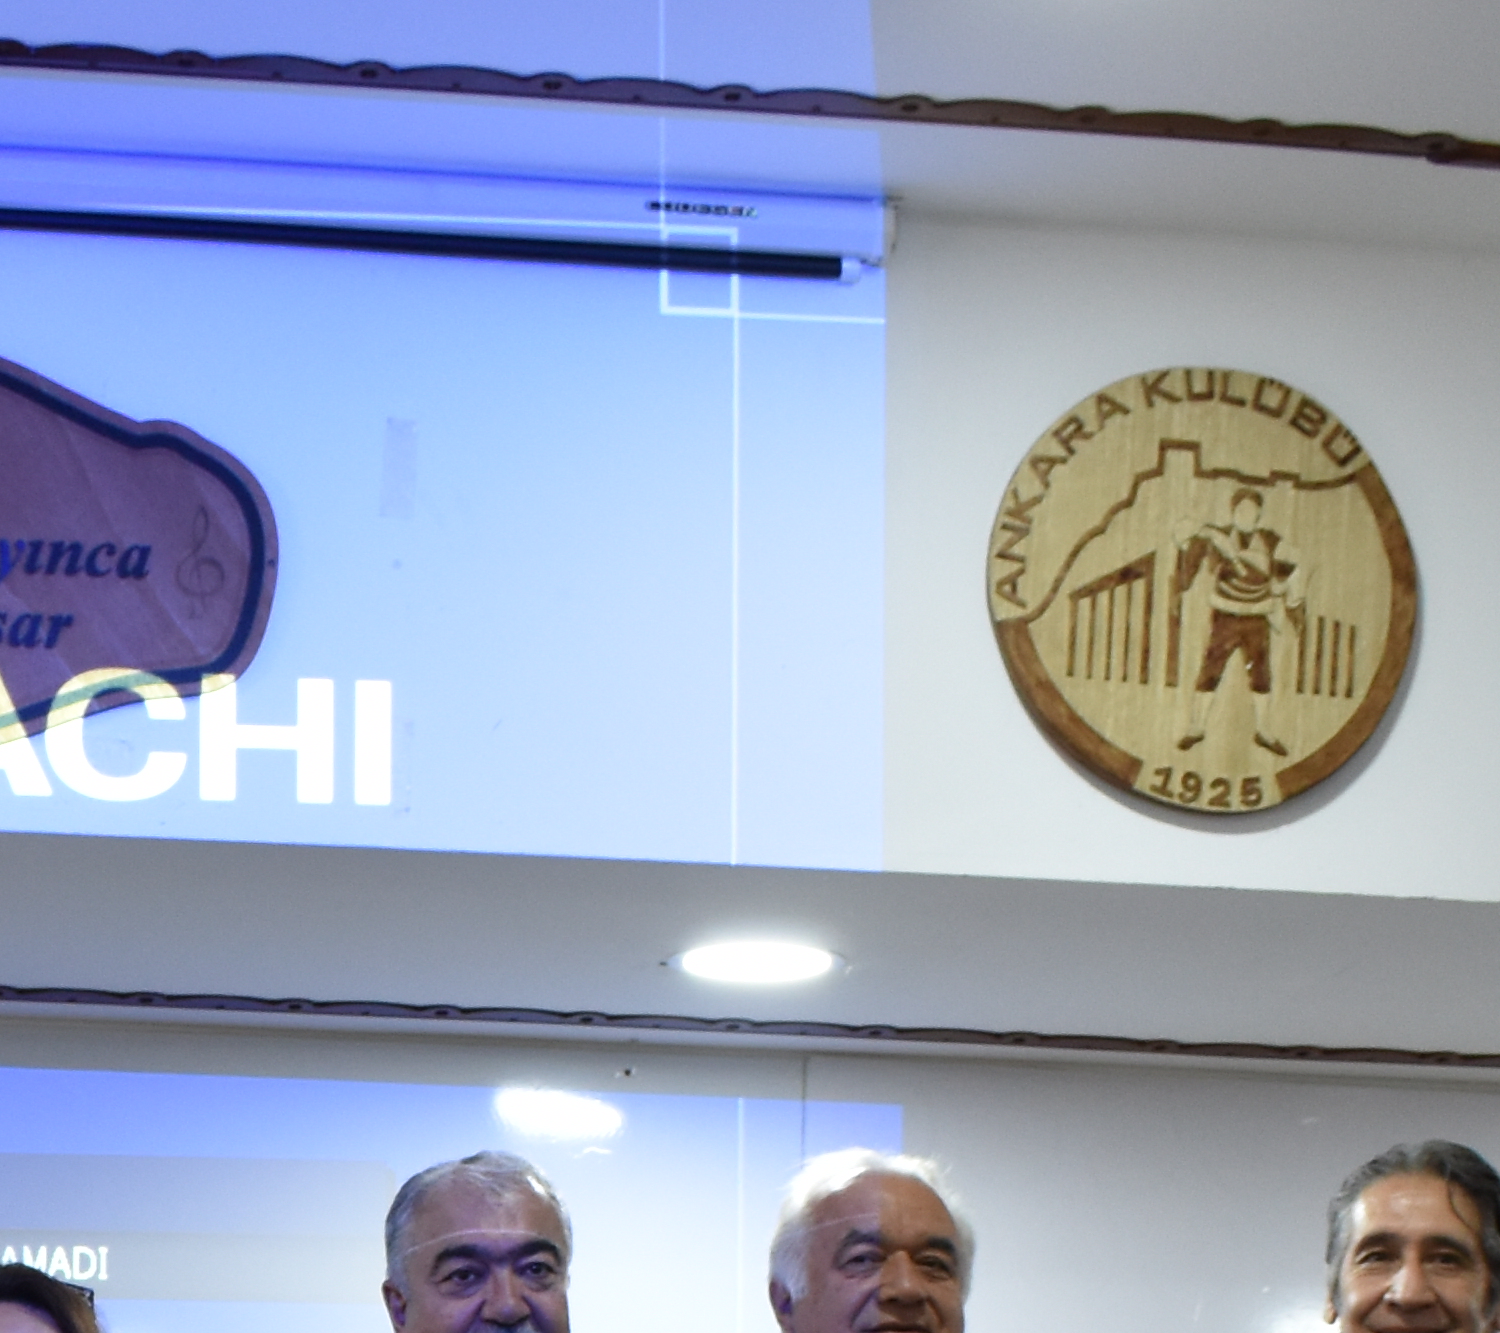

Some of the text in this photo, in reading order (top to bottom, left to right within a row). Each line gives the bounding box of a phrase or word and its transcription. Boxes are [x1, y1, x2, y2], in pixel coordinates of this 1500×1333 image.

[994, 368, 1361, 608] ANKARA KULÜBÜ
[1150, 766, 1264, 809] 1925
